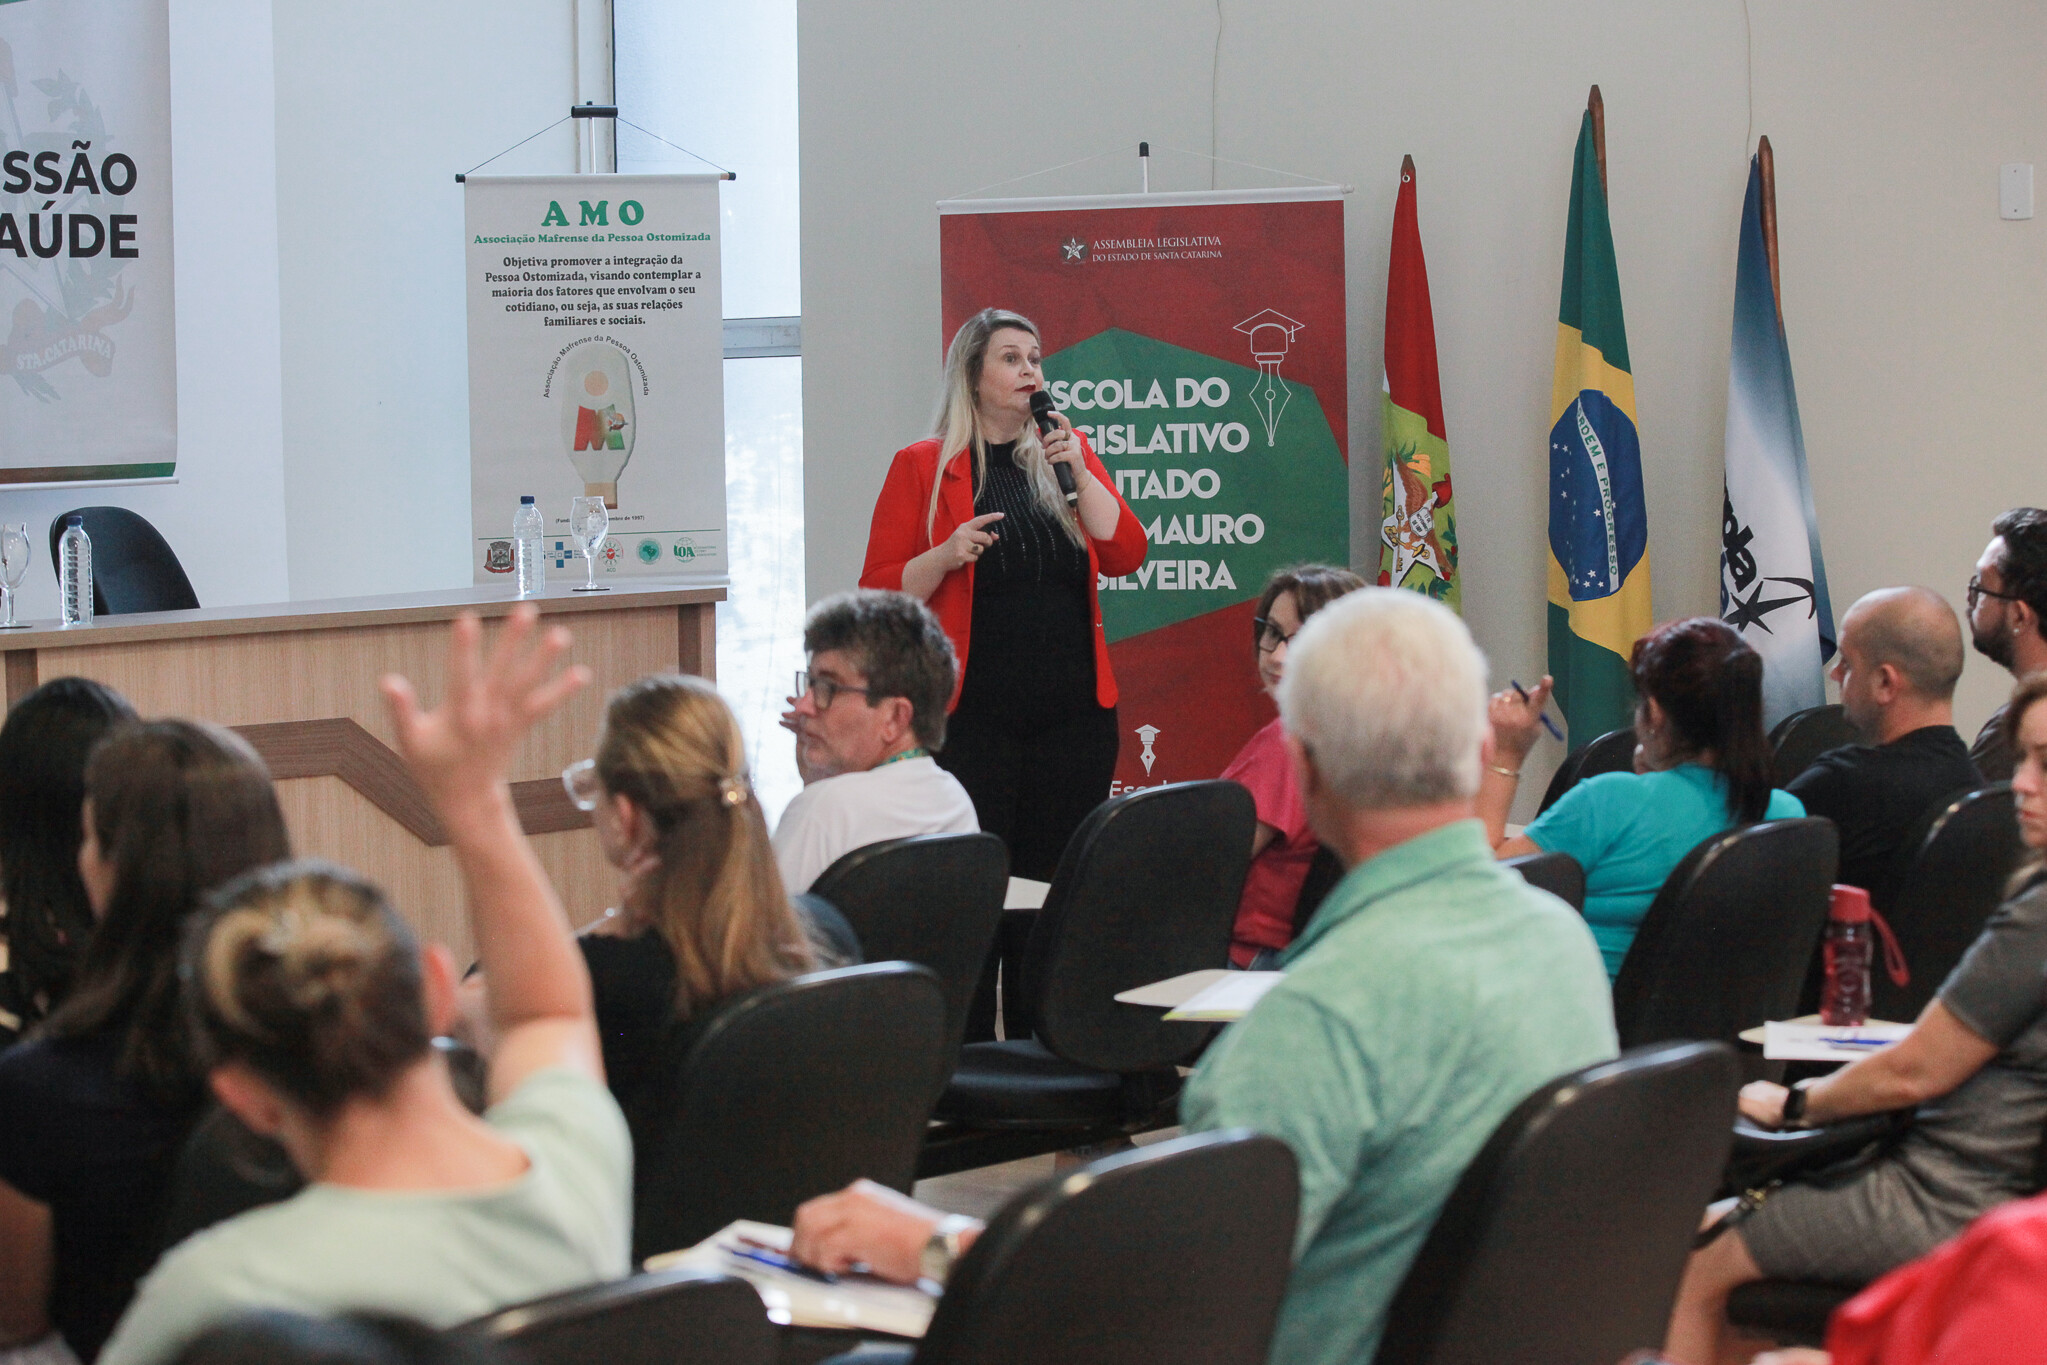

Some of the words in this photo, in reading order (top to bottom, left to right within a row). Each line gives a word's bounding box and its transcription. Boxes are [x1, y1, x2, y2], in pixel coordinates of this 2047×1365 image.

[3, 140, 138, 196] SSÃO
[0, 200, 139, 258] AÚDE
[474, 234, 535, 245] Associação
[538, 234, 589, 243] Mafrense
[591, 233, 605, 242] da
[608, 233, 644, 242] Pessoa
[646, 232, 711, 242] Ostomizada
[1093, 238, 1154, 249] ASSEMBLEIA
[1157, 236, 1222, 247] LEGISLATIVA
[503, 256, 548, 269] Objetiva
[550, 258, 602, 269] promover
[613, 254, 668, 267] integração
[670, 255, 683, 265] da
[1092, 253, 1106, 262] DO
[1107, 252, 1139, 261] ESTADO
[1140, 252, 1151, 260] DE
[1153, 251, 1180, 260] SANTA
[1180, 250, 1222, 259] CATARINA
[485, 272, 520, 282] Pessoa
[522, 271, 588, 282] Ostomizada,
[590, 270, 630, 280] visando
[633, 269, 693, 281] contemplar
[695, 271, 702, 279] a
[492, 287, 533, 297] maioria
[535, 286, 554, 296] dos
[556, 286, 593, 296] fatores
[596, 287, 615, 297] que
[617, 285, 667, 295] envolvam
[669, 286, 676, 294] o
[678, 286, 696, 294] seu
[505, 302, 559, 313] cotidiano,
[560, 303, 574, 311] ou
[576, 301, 600, 313] seja,
[602, 302, 614, 310] as
[616, 301, 639, 310] suas
[641, 299, 683, 311] relações
[544, 316, 598, 326] familiares
[600, 317, 606, 325] e
[608, 315, 646, 325] sociais.
[543, 356, 561, 398] Associação
[559, 335, 592, 357] Mafrense
[594, 334, 604, 342] da
[606, 335, 632, 354] Pessoa
[630, 353, 650, 396] Ostomizada
[1043, 378, 1170, 411] SCOLA
[1175, 376, 1230, 408] DO
[1597, 462, 1606, 471] E
[1600, 477, 1618, 576] PROGRESSO
